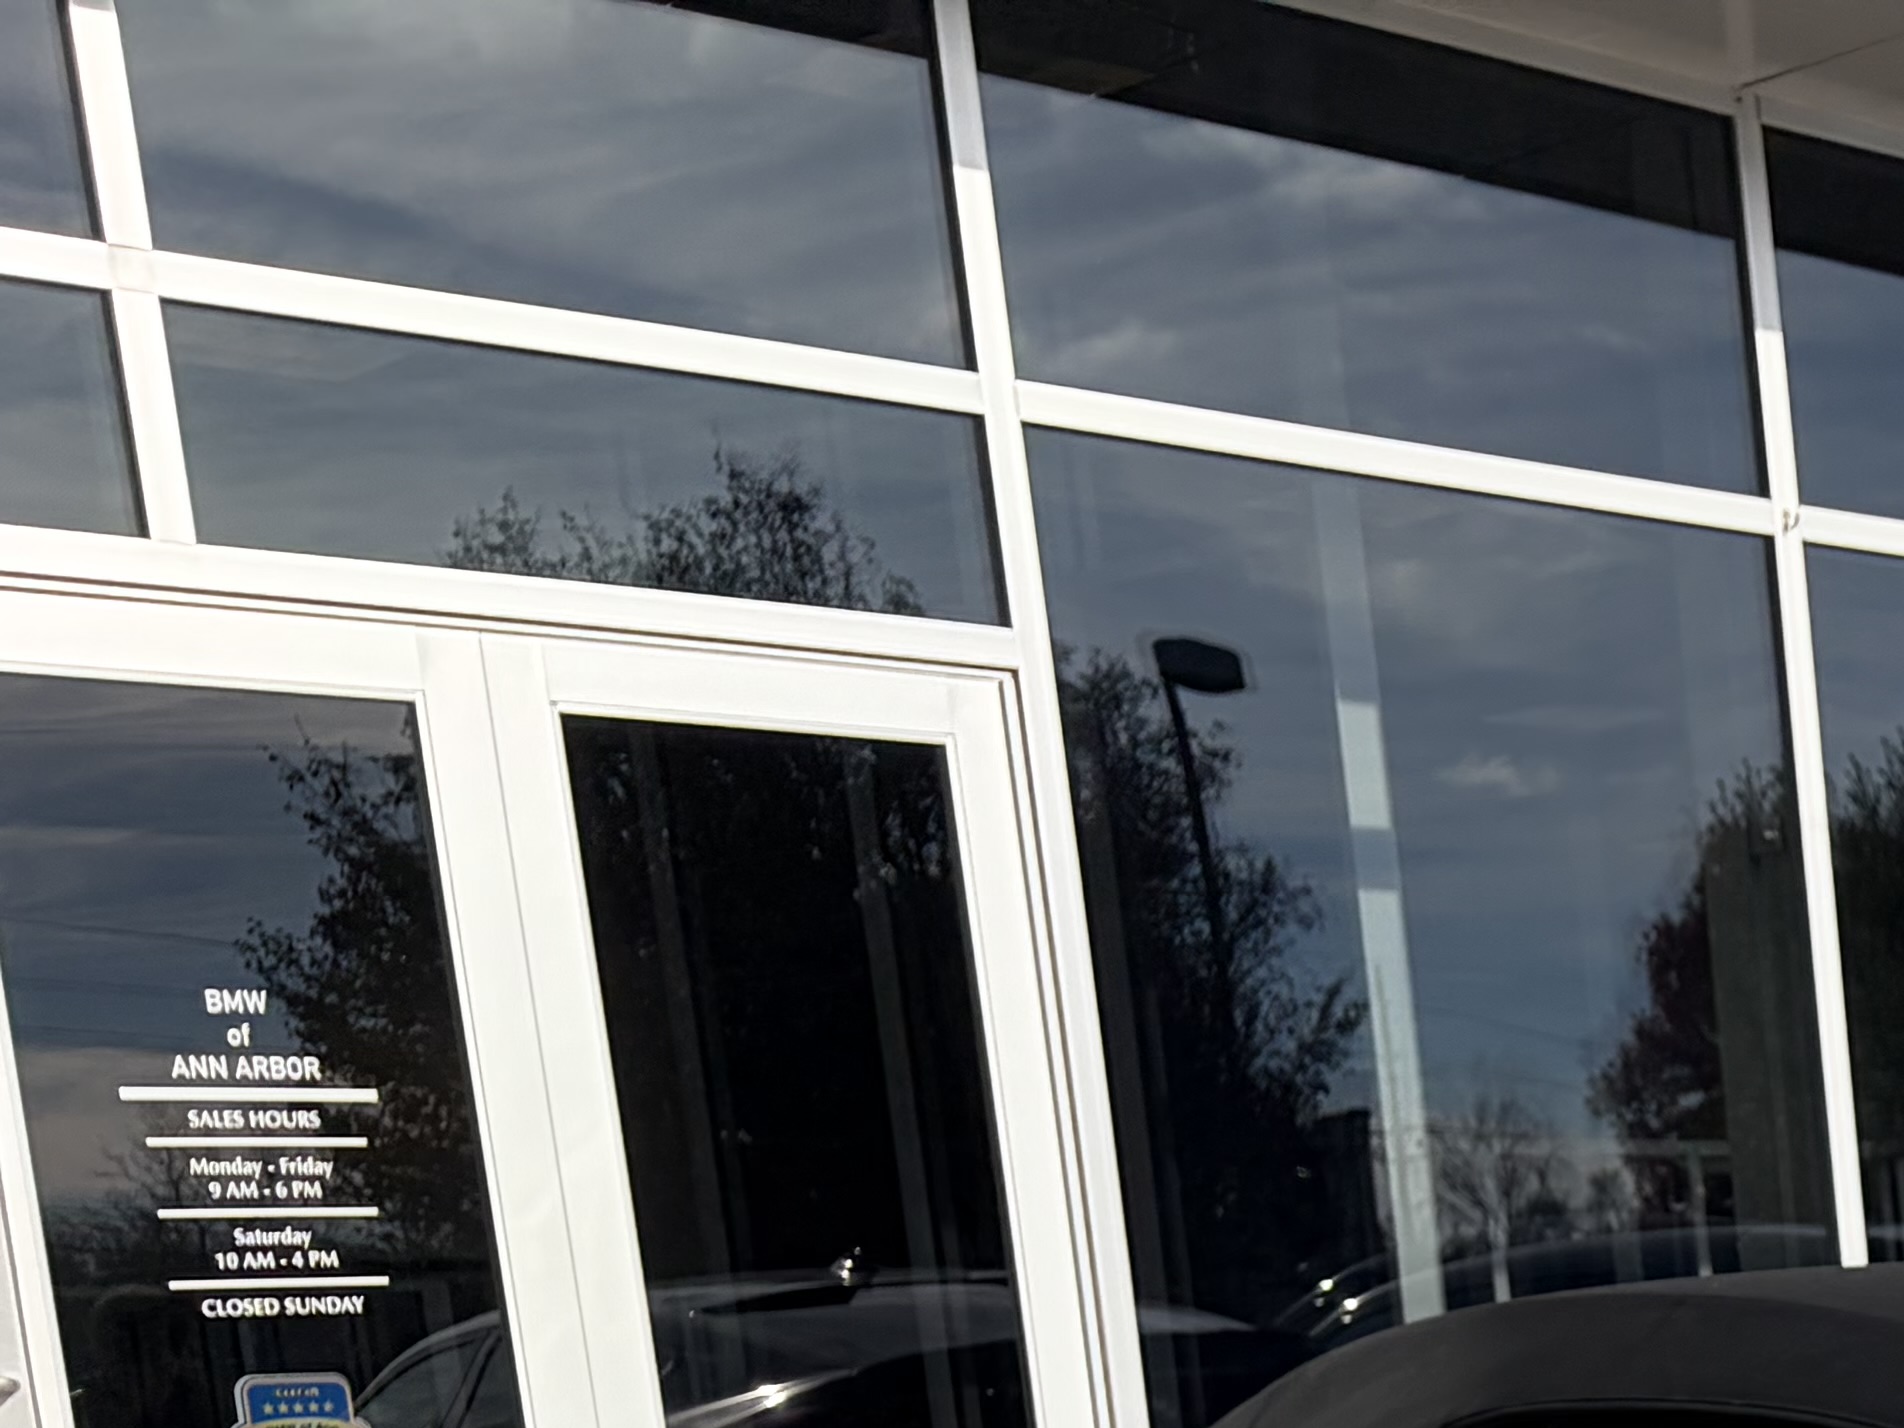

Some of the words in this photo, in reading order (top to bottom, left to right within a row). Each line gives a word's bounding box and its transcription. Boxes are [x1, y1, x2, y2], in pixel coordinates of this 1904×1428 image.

[204, 988, 268, 1015] BMW
[226, 1022, 251, 1048] of
[171, 1054, 229, 1080] ANN
[235, 1055, 322, 1081] ARBOR
[187, 1109, 245, 1129] SALES
[249, 1109, 322, 1129] HOURS
[189, 1156, 263, 1180] Monday
[279, 1156, 334, 1180] Friday
[208, 1181, 221, 1200] 9
[226, 1181, 259, 1200] AM
[275, 1181, 288, 1199] 6
[292, 1180, 323, 1199] PM
[233, 1225, 313, 1250] Saturday
[215, 1251, 239, 1271] 10
[243, 1251, 276, 1270] AM
[291, 1251, 304, 1269] 4
[308, 1250, 340, 1269] PM
[201, 1297, 281, 1319] CLOSED
[284, 1295, 365, 1317] SUNDAY
